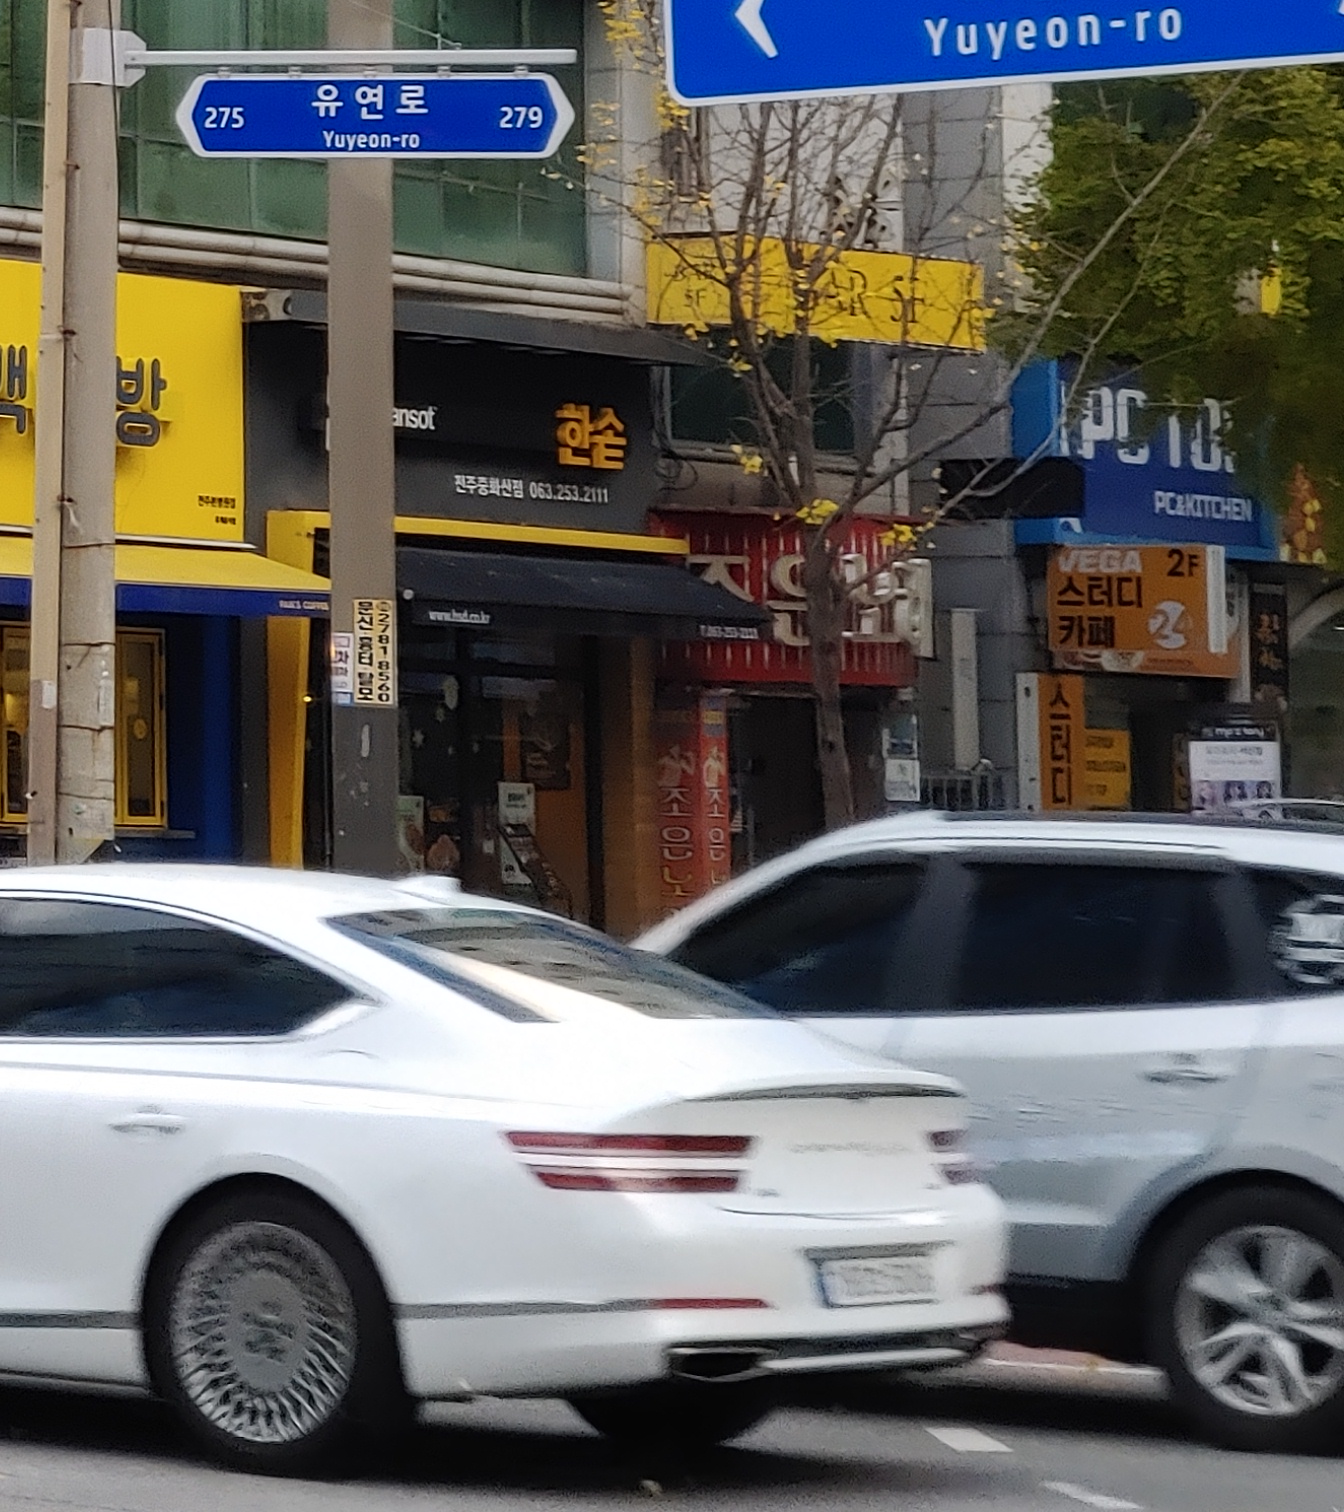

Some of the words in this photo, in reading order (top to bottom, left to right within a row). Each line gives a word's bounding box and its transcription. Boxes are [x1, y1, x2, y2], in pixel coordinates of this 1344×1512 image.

[923, 4, 1184, 60] Yuyeon-ro
[310, 81, 430, 117] 유연로
[202, 104, 246, 132] 275
[498, 104, 544, 131] 279
[321, 128, 422, 153] Yuyeon-ro
[554, 401, 628, 471] 한솥
[528, 481, 609, 504] 063.253.2111
[1153, 490, 1253, 523] PC&KITCHEN
[1166, 548, 1201, 577] 2F
[1056, 574, 1143, 609] 스터디
[1057, 614, 1115, 649] 카페
[1048, 682, 1073, 806] 스터디
